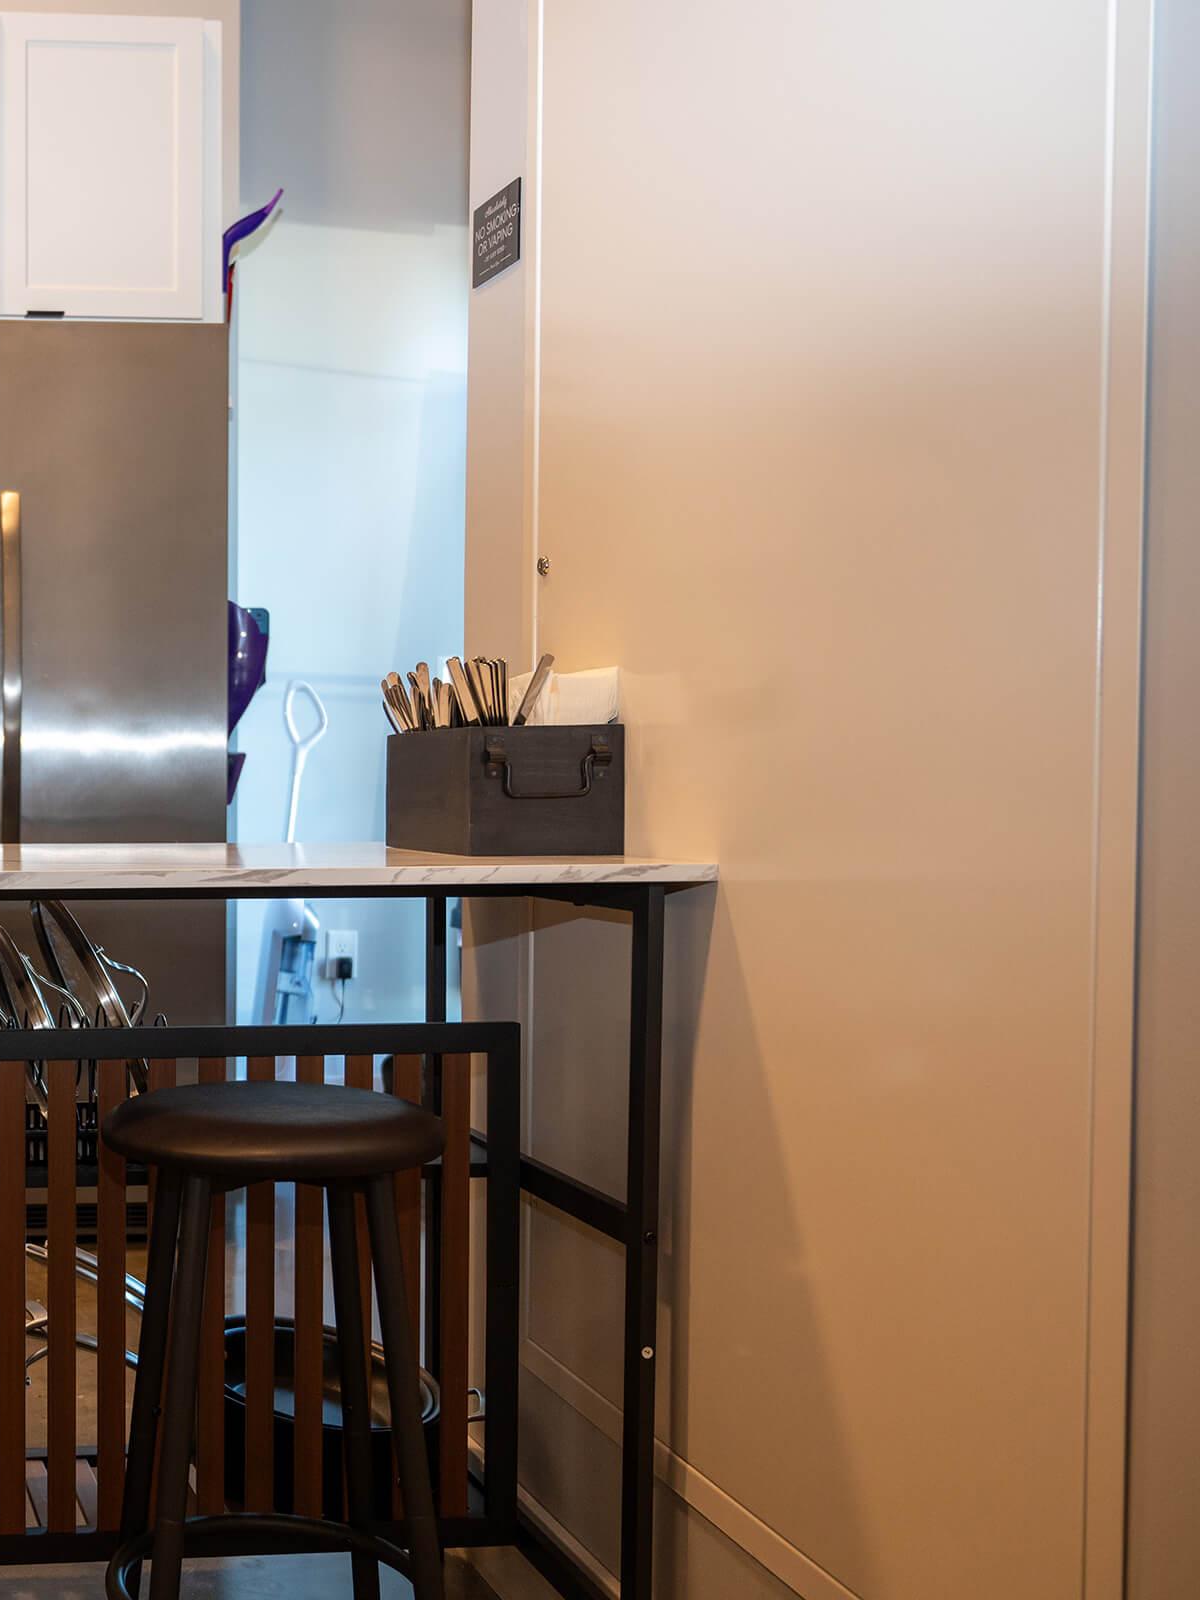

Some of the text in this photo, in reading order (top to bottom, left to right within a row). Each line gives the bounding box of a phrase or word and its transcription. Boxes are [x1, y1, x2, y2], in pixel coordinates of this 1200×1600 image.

[474, 203, 517, 244] NO SMOKING
[477, 240, 488, 257] OR
[487, 222, 513, 249] VAPING
